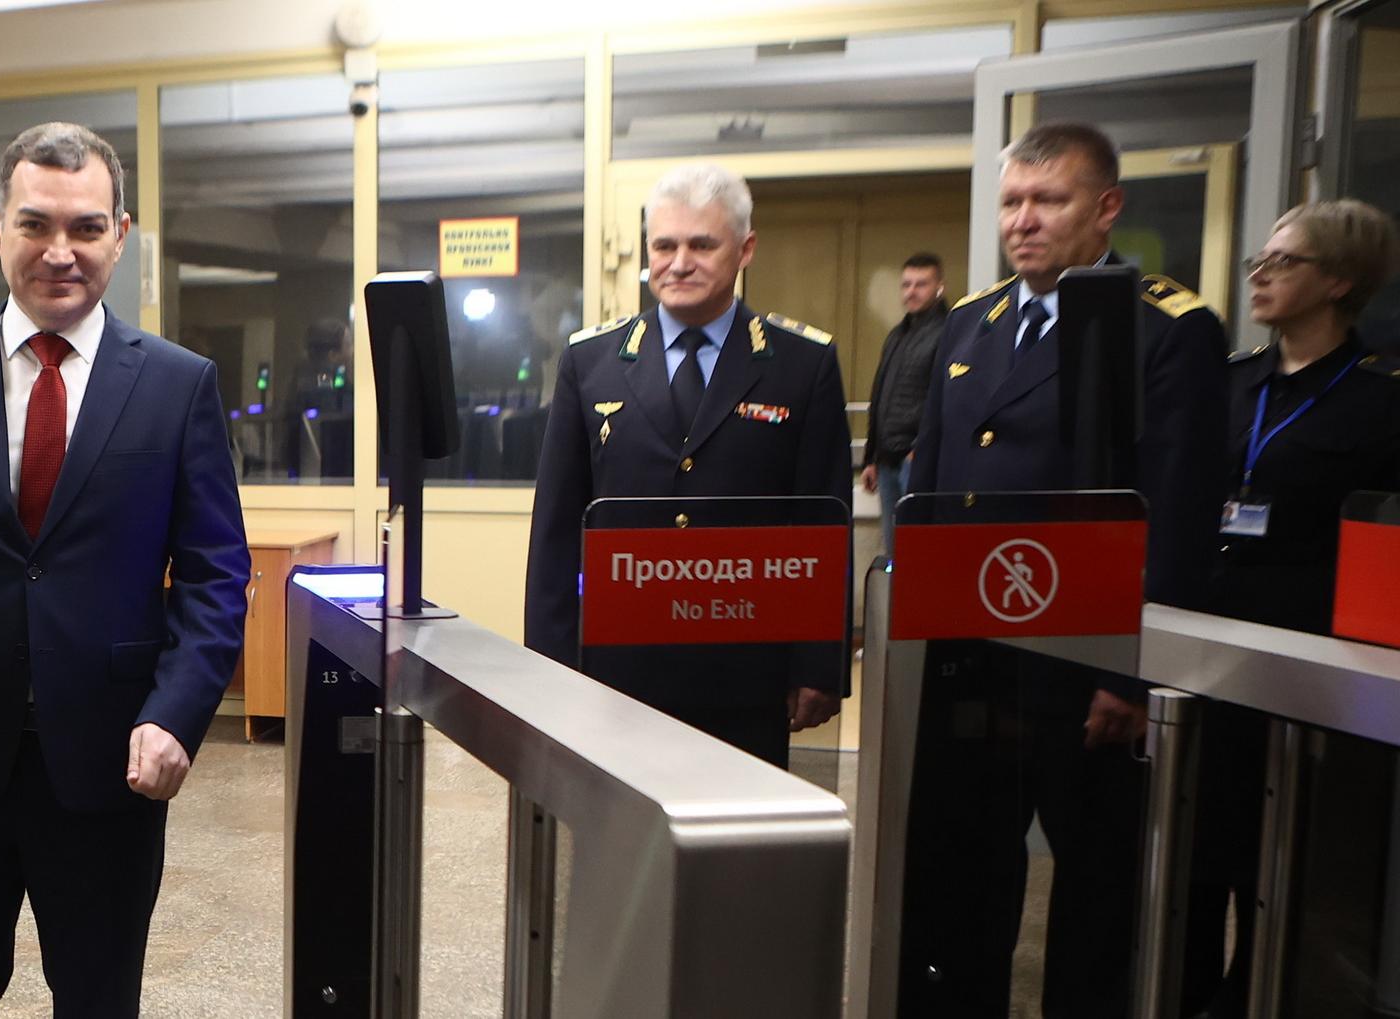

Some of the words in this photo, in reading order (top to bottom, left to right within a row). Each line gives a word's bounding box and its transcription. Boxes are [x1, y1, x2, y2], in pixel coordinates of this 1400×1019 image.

[611, 552, 753, 588] Прохода
[764, 556, 818, 579] нет
[671, 599, 703, 620] No
[710, 598, 756, 619] Exit
[322, 671, 339, 684] 13
